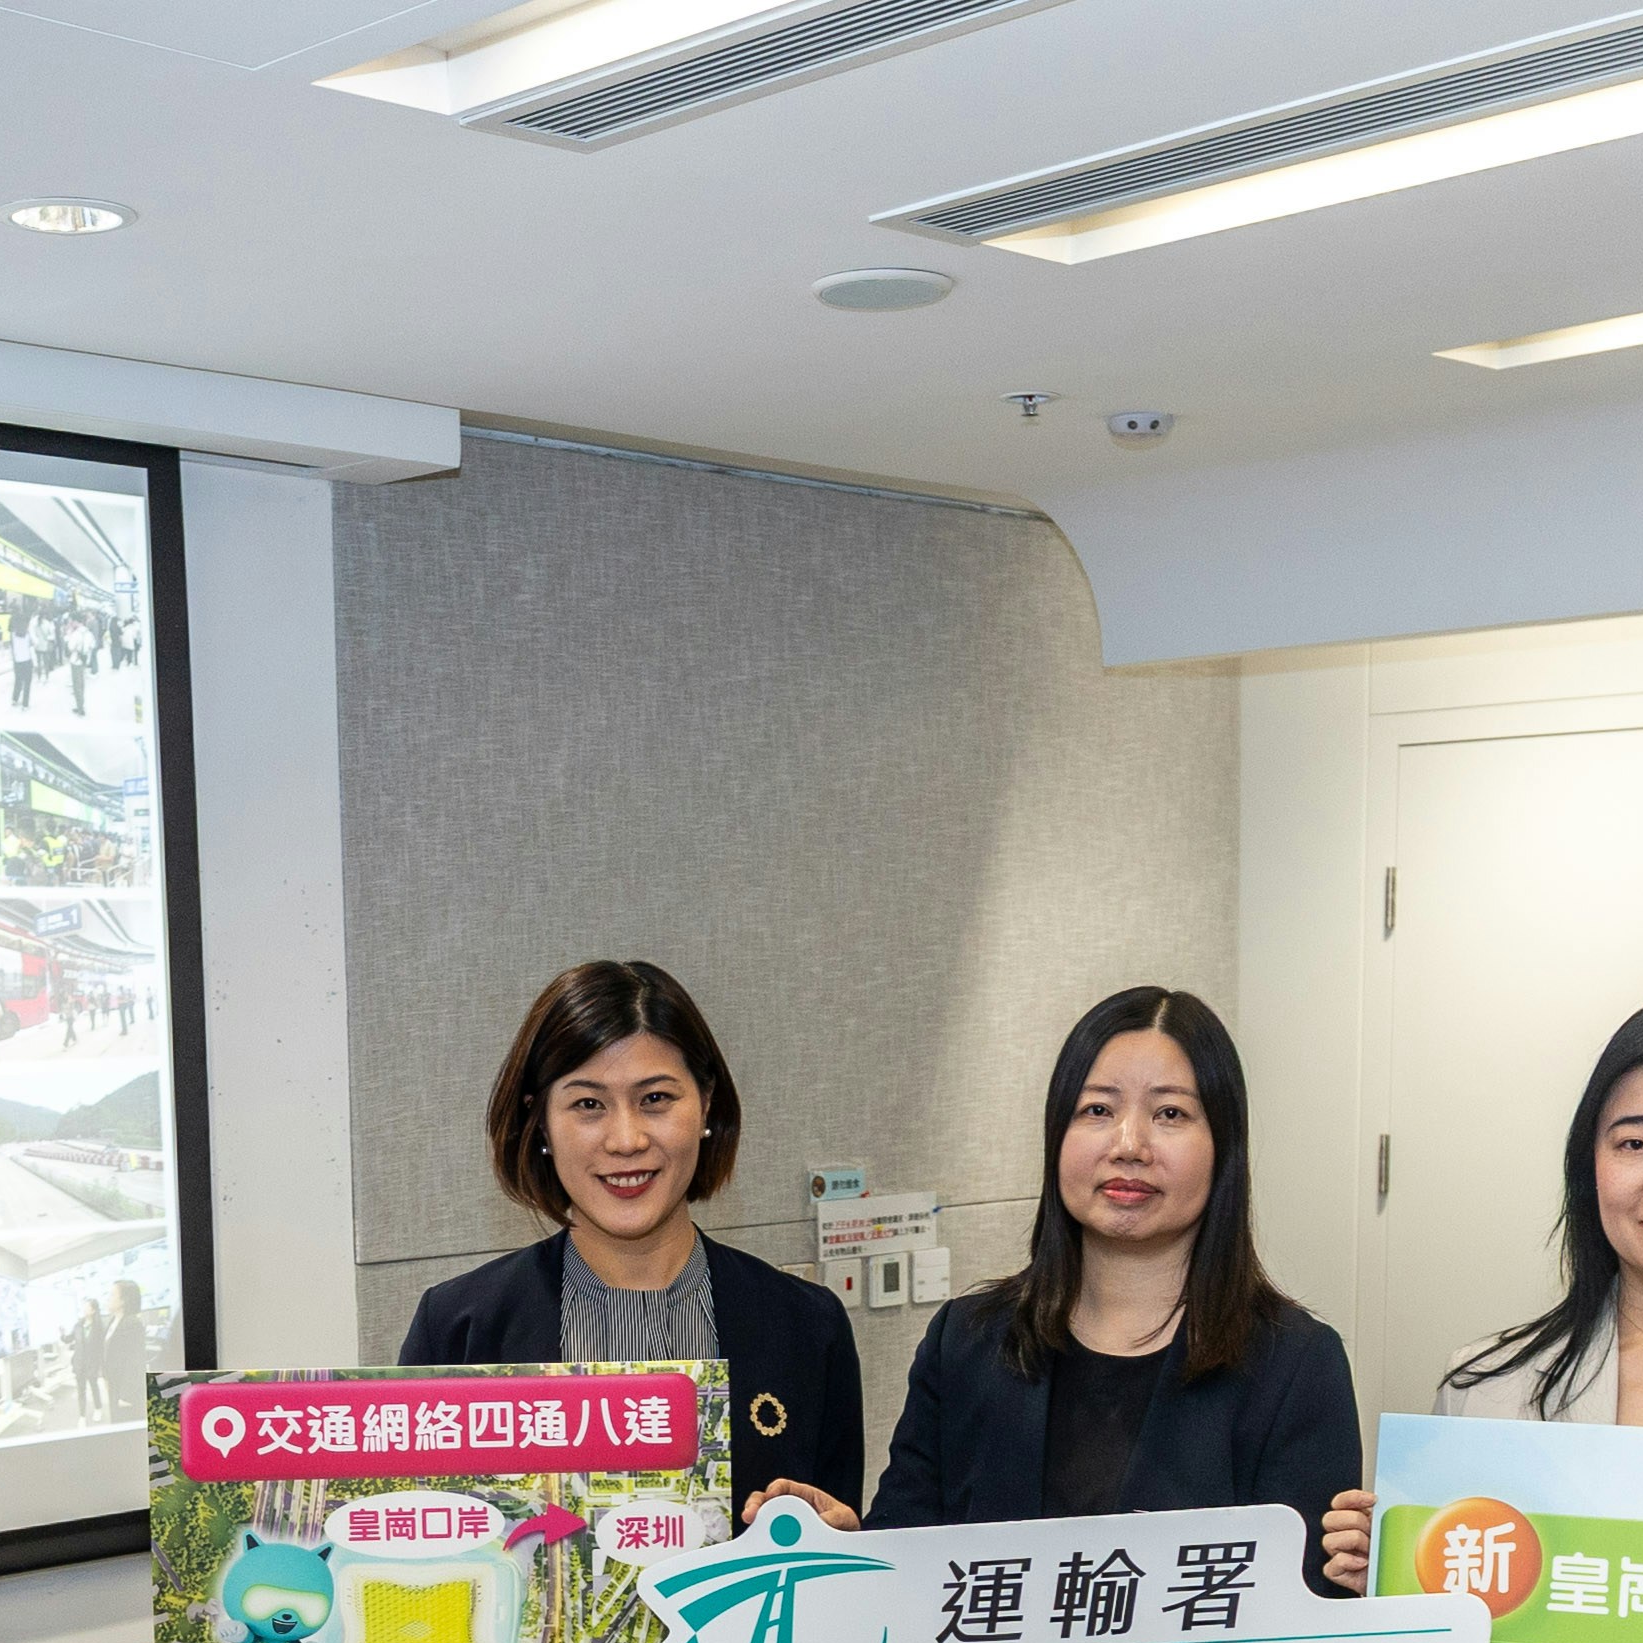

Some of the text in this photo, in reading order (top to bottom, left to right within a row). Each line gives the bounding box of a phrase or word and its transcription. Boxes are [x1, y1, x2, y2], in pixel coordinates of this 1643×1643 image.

[255, 1395, 673, 1456] 交通網絡四通八達
[347, 1506, 491, 1544] 皇崗口岸
[615, 1515, 686, 1551] 深圳
[1442, 1521, 1517, 1596] 新
